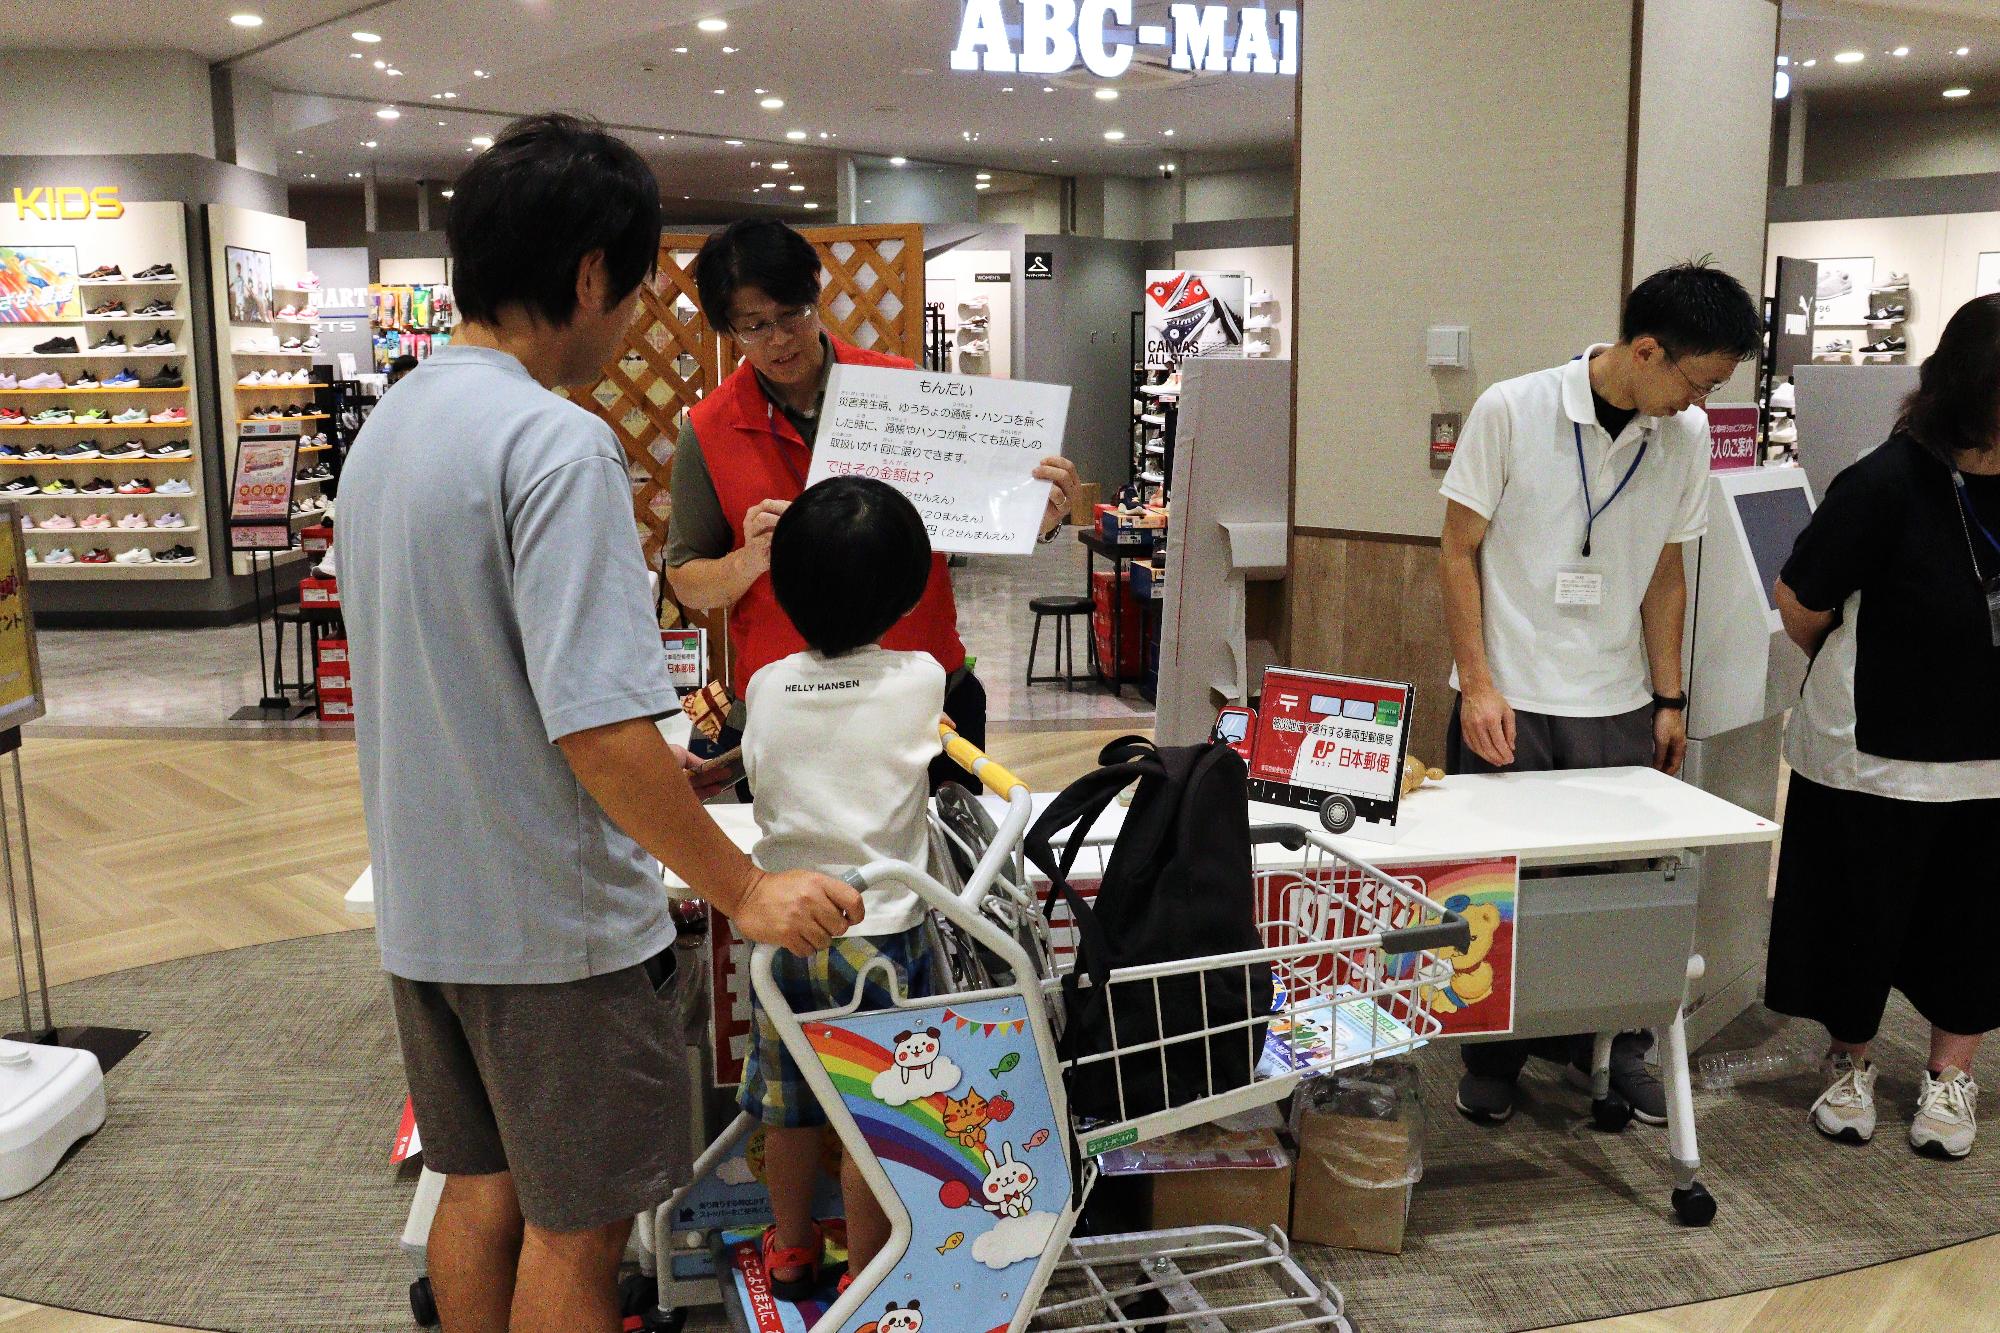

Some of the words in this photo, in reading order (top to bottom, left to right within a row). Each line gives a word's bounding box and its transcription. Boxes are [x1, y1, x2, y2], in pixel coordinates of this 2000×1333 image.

[13, 186, 125, 221] KIDS
[1147, 340, 1199, 353] CANVAS
[1147, 354, 1165, 365] ALL
[919, 379, 974, 397] もんだい
[826, 460, 935, 485] ではその金額は？
[784, 683, 815, 693] HELLY
[816, 679, 860, 692] HANSEN
[1338, 747, 1392, 774] 日本郵便
[743, 1259, 780, 1333] ここよりまえに、
